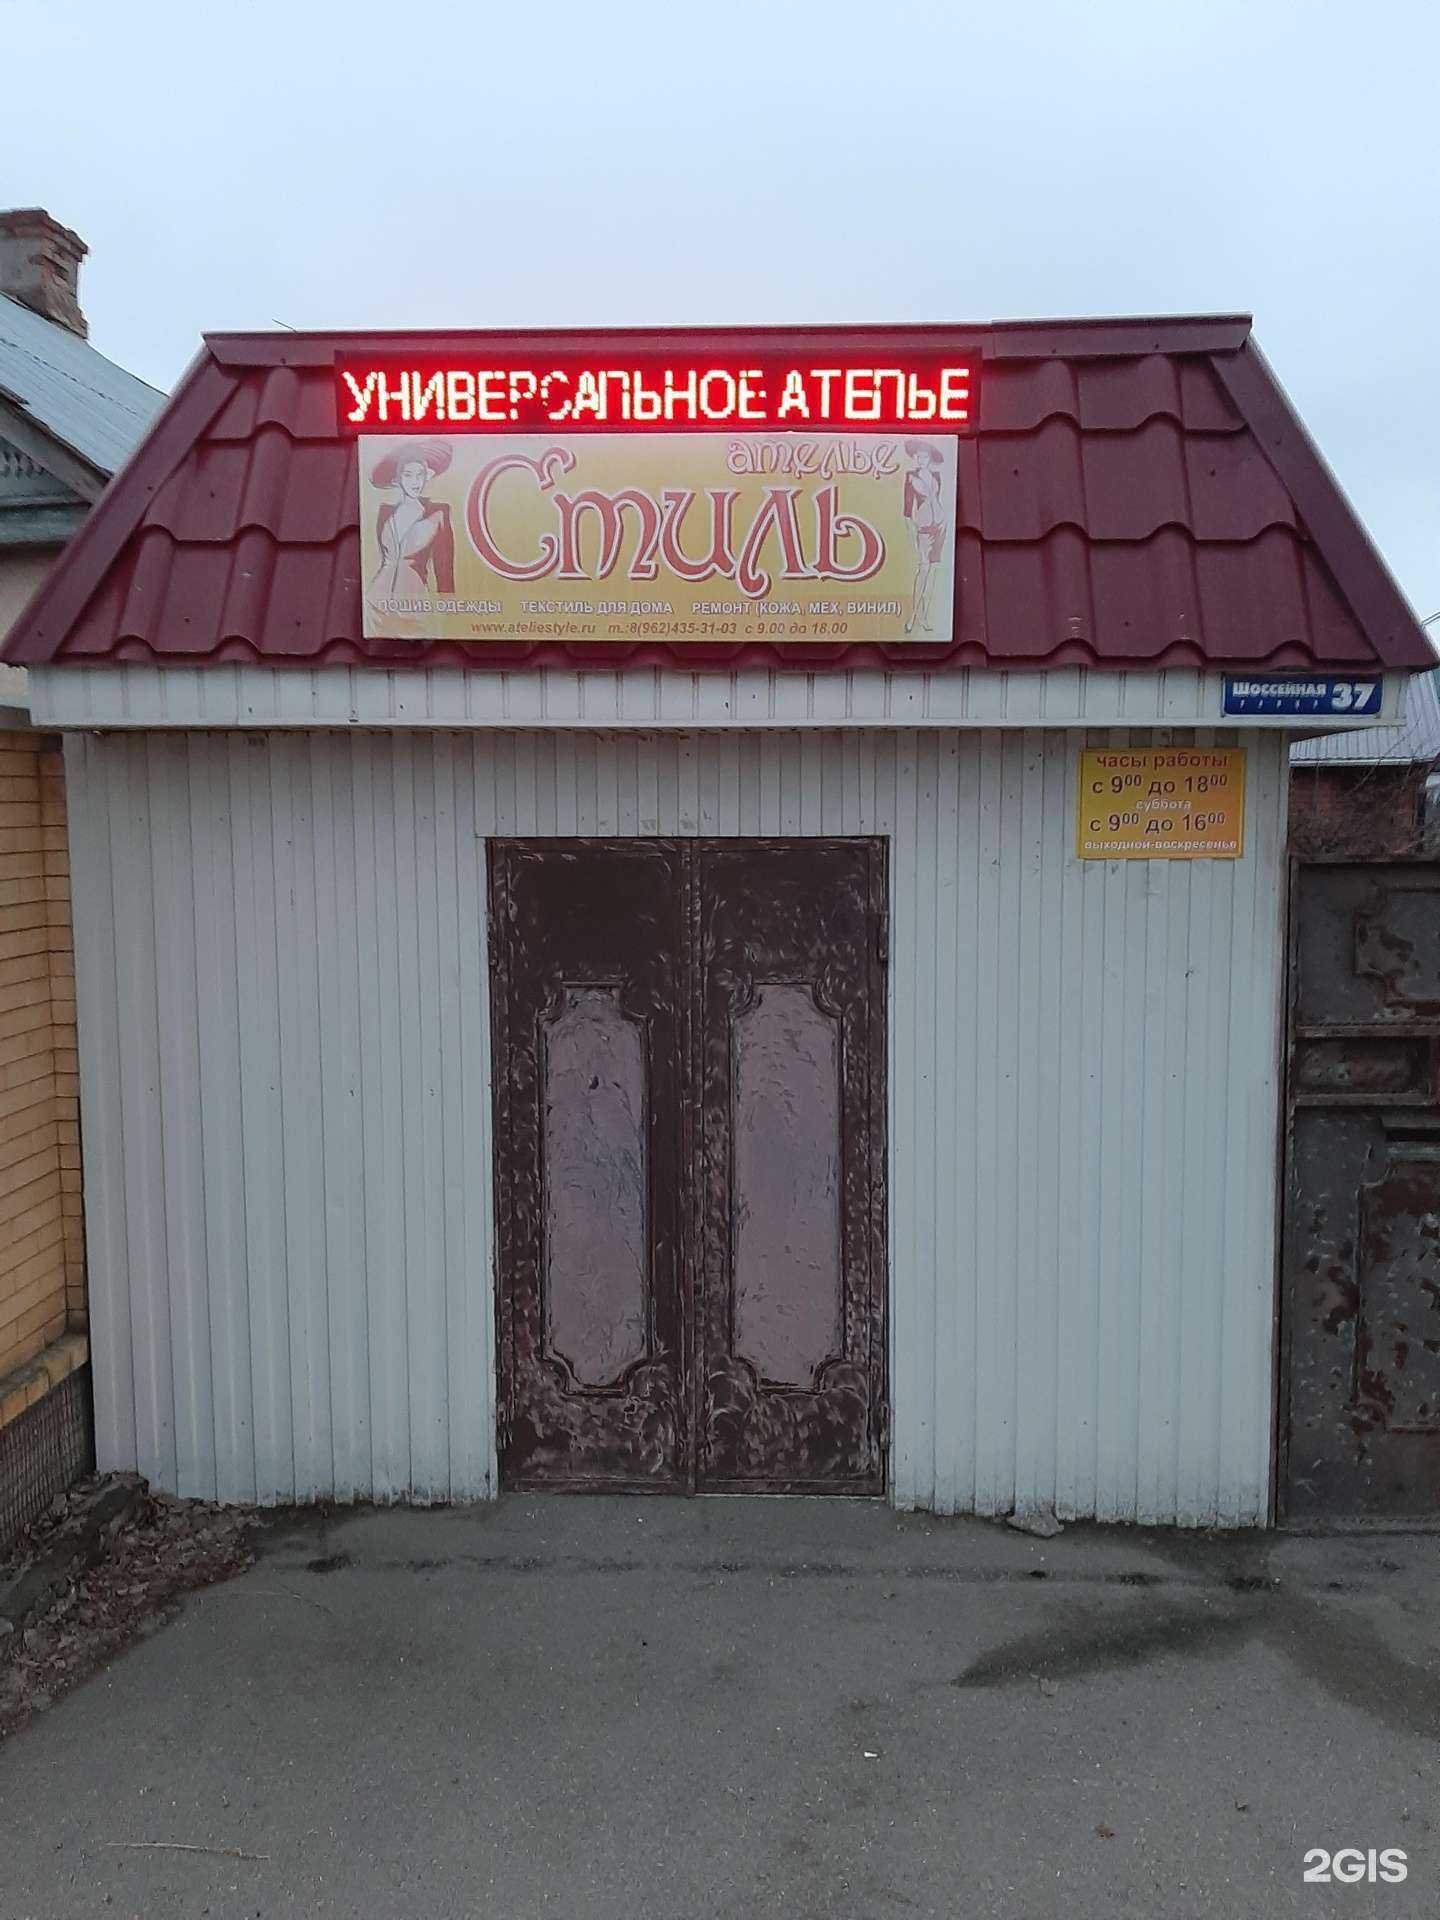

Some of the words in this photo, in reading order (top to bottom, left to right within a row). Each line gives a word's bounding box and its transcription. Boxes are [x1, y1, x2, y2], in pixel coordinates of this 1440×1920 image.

[727, 440, 900, 479] ателье
[466, 446, 887, 599] Стиль
[376, 599, 432, 614] ПОШИВ
[436, 600, 503, 615] ОДЕЖДЫ
[520, 600, 594, 614] ТЕКСТИЛЬ
[597, 600, 627, 615] ДЛЯ
[630, 600, 673, 616] ДОМА
[692, 601, 751, 614] РЕМОНТ
[809, 601, 843, 615] МЕХ,
[847, 600, 902, 615] ВИНИЛ)
[471, 621, 597, 635] www.ateliestyle.ru
[757, 622, 786, 635] 9.00
[789, 621, 808, 635] до
[812, 622, 848, 635] 18.00
[1331, 683, 1376, 710] 37
[1097, 755, 1147, 768] часы
[1154, 752, 1228, 770] работы
[1092, 781, 1103, 794] с
[1148, 780, 1176, 796] до
[1136, 799, 1192, 812] суббота
[1090, 819, 1101, 832] с
[1145, 818, 1173, 834] до
